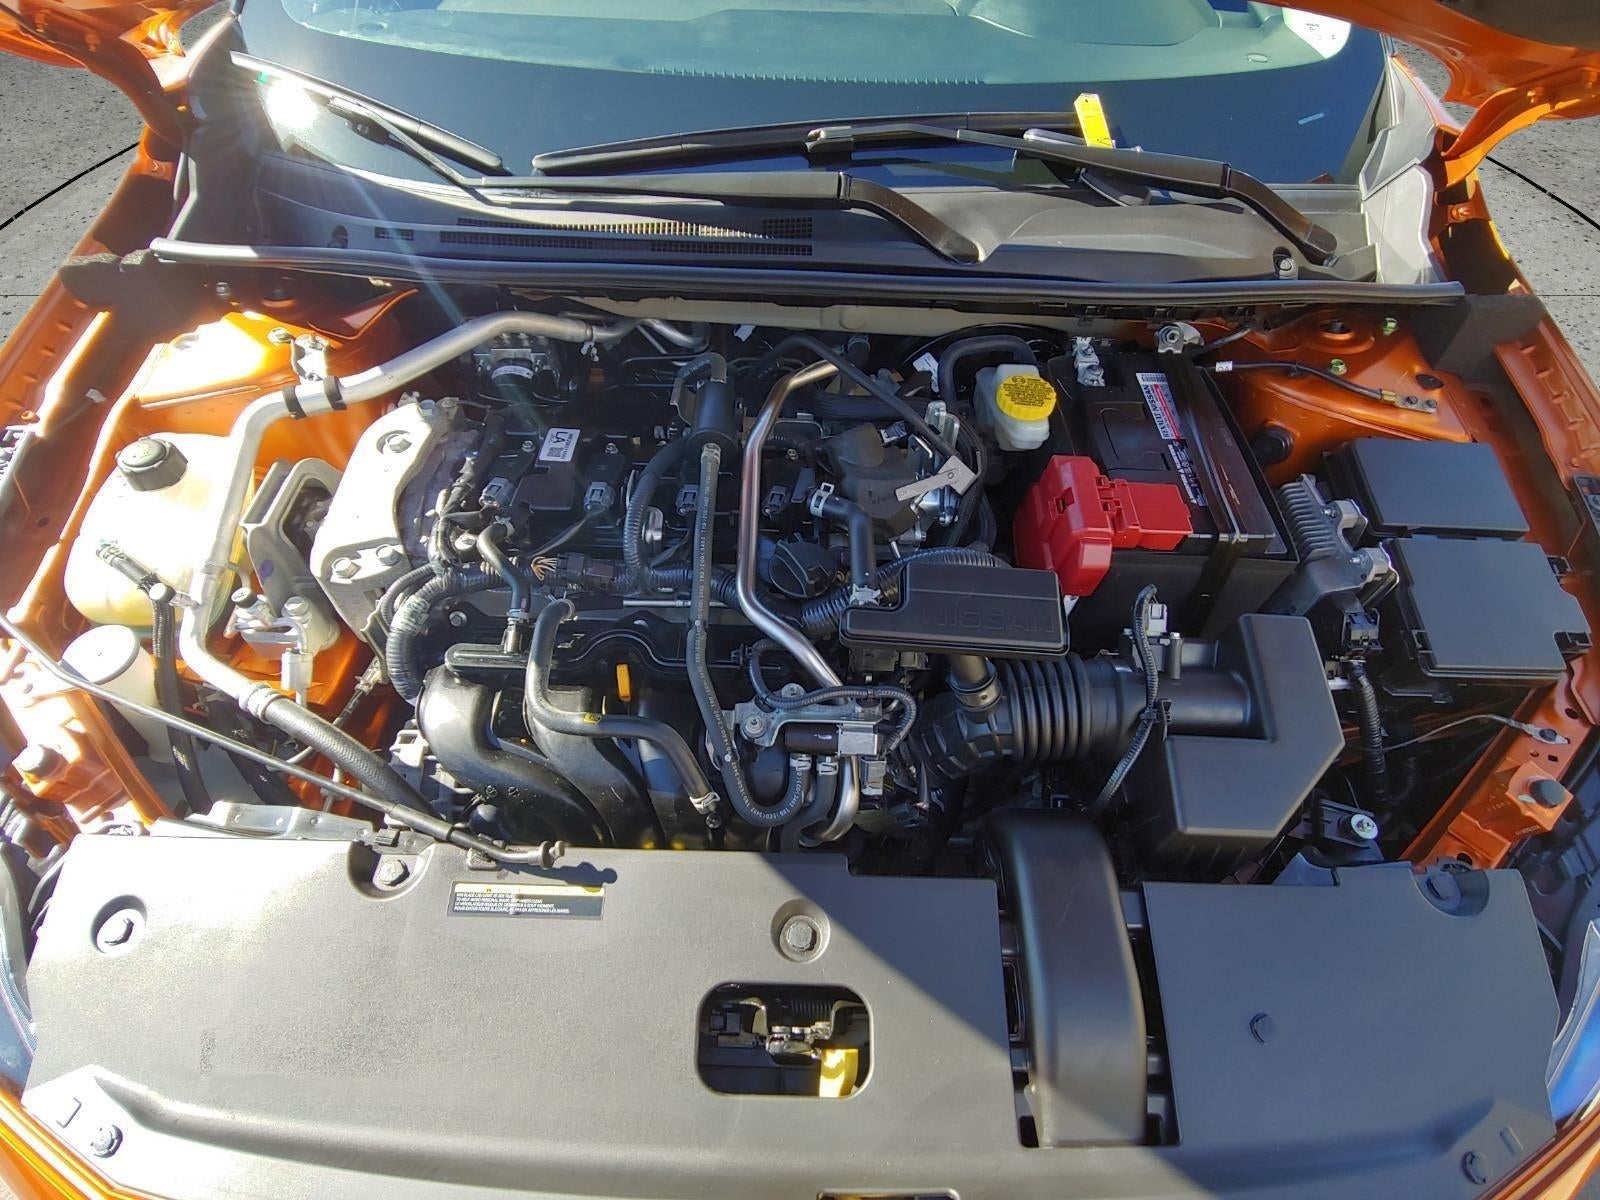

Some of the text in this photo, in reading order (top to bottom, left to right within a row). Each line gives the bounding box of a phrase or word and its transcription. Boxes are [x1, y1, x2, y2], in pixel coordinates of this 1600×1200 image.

[1143, 384, 1160, 413] NISSAN
[552, 431, 568, 444] LA
[922, 607, 1055, 633] NISSAN
